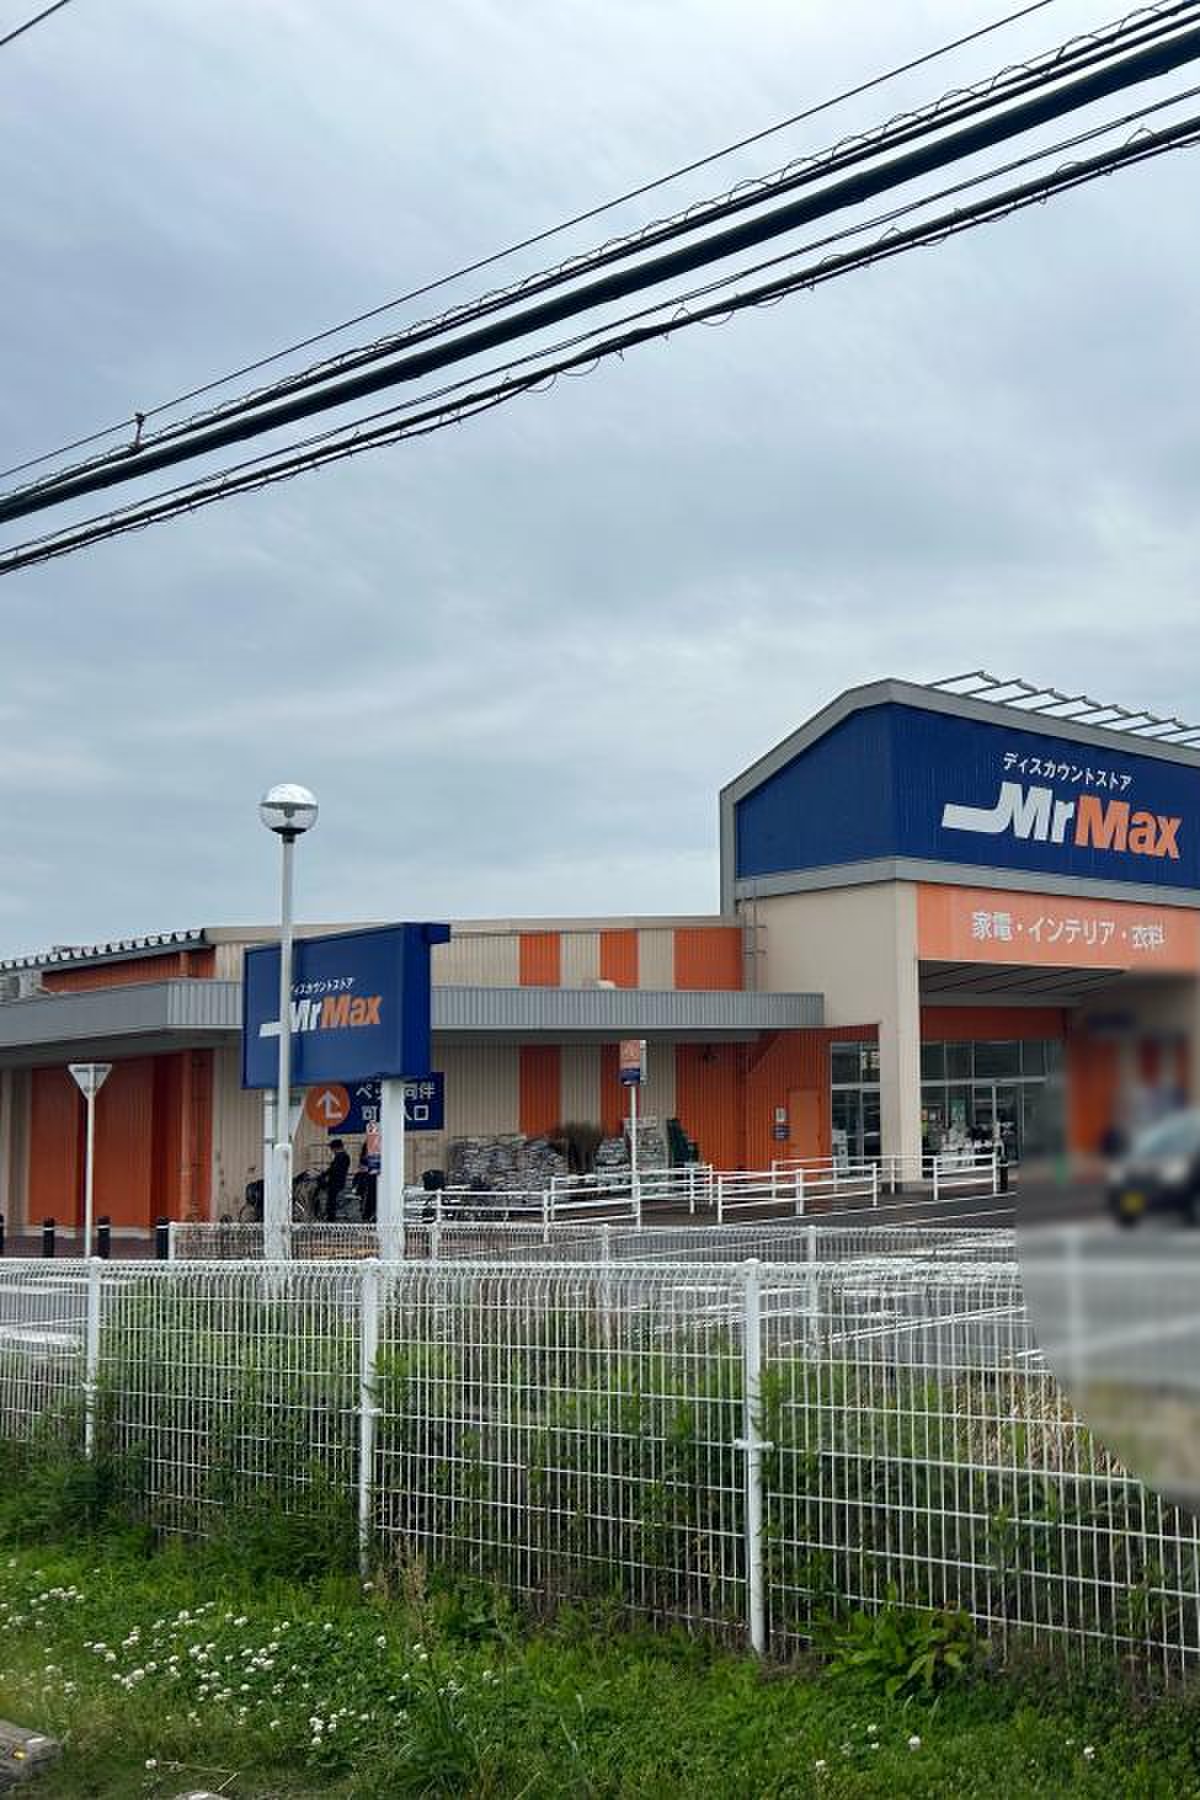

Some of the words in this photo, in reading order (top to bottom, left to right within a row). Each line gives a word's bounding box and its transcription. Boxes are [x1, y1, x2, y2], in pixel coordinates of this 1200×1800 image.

[1003, 752, 1133, 791] ディスカウントストア
[942, 782, 1181, 859] MrMax
[355, 1081, 436, 1100] ペッ同伴
